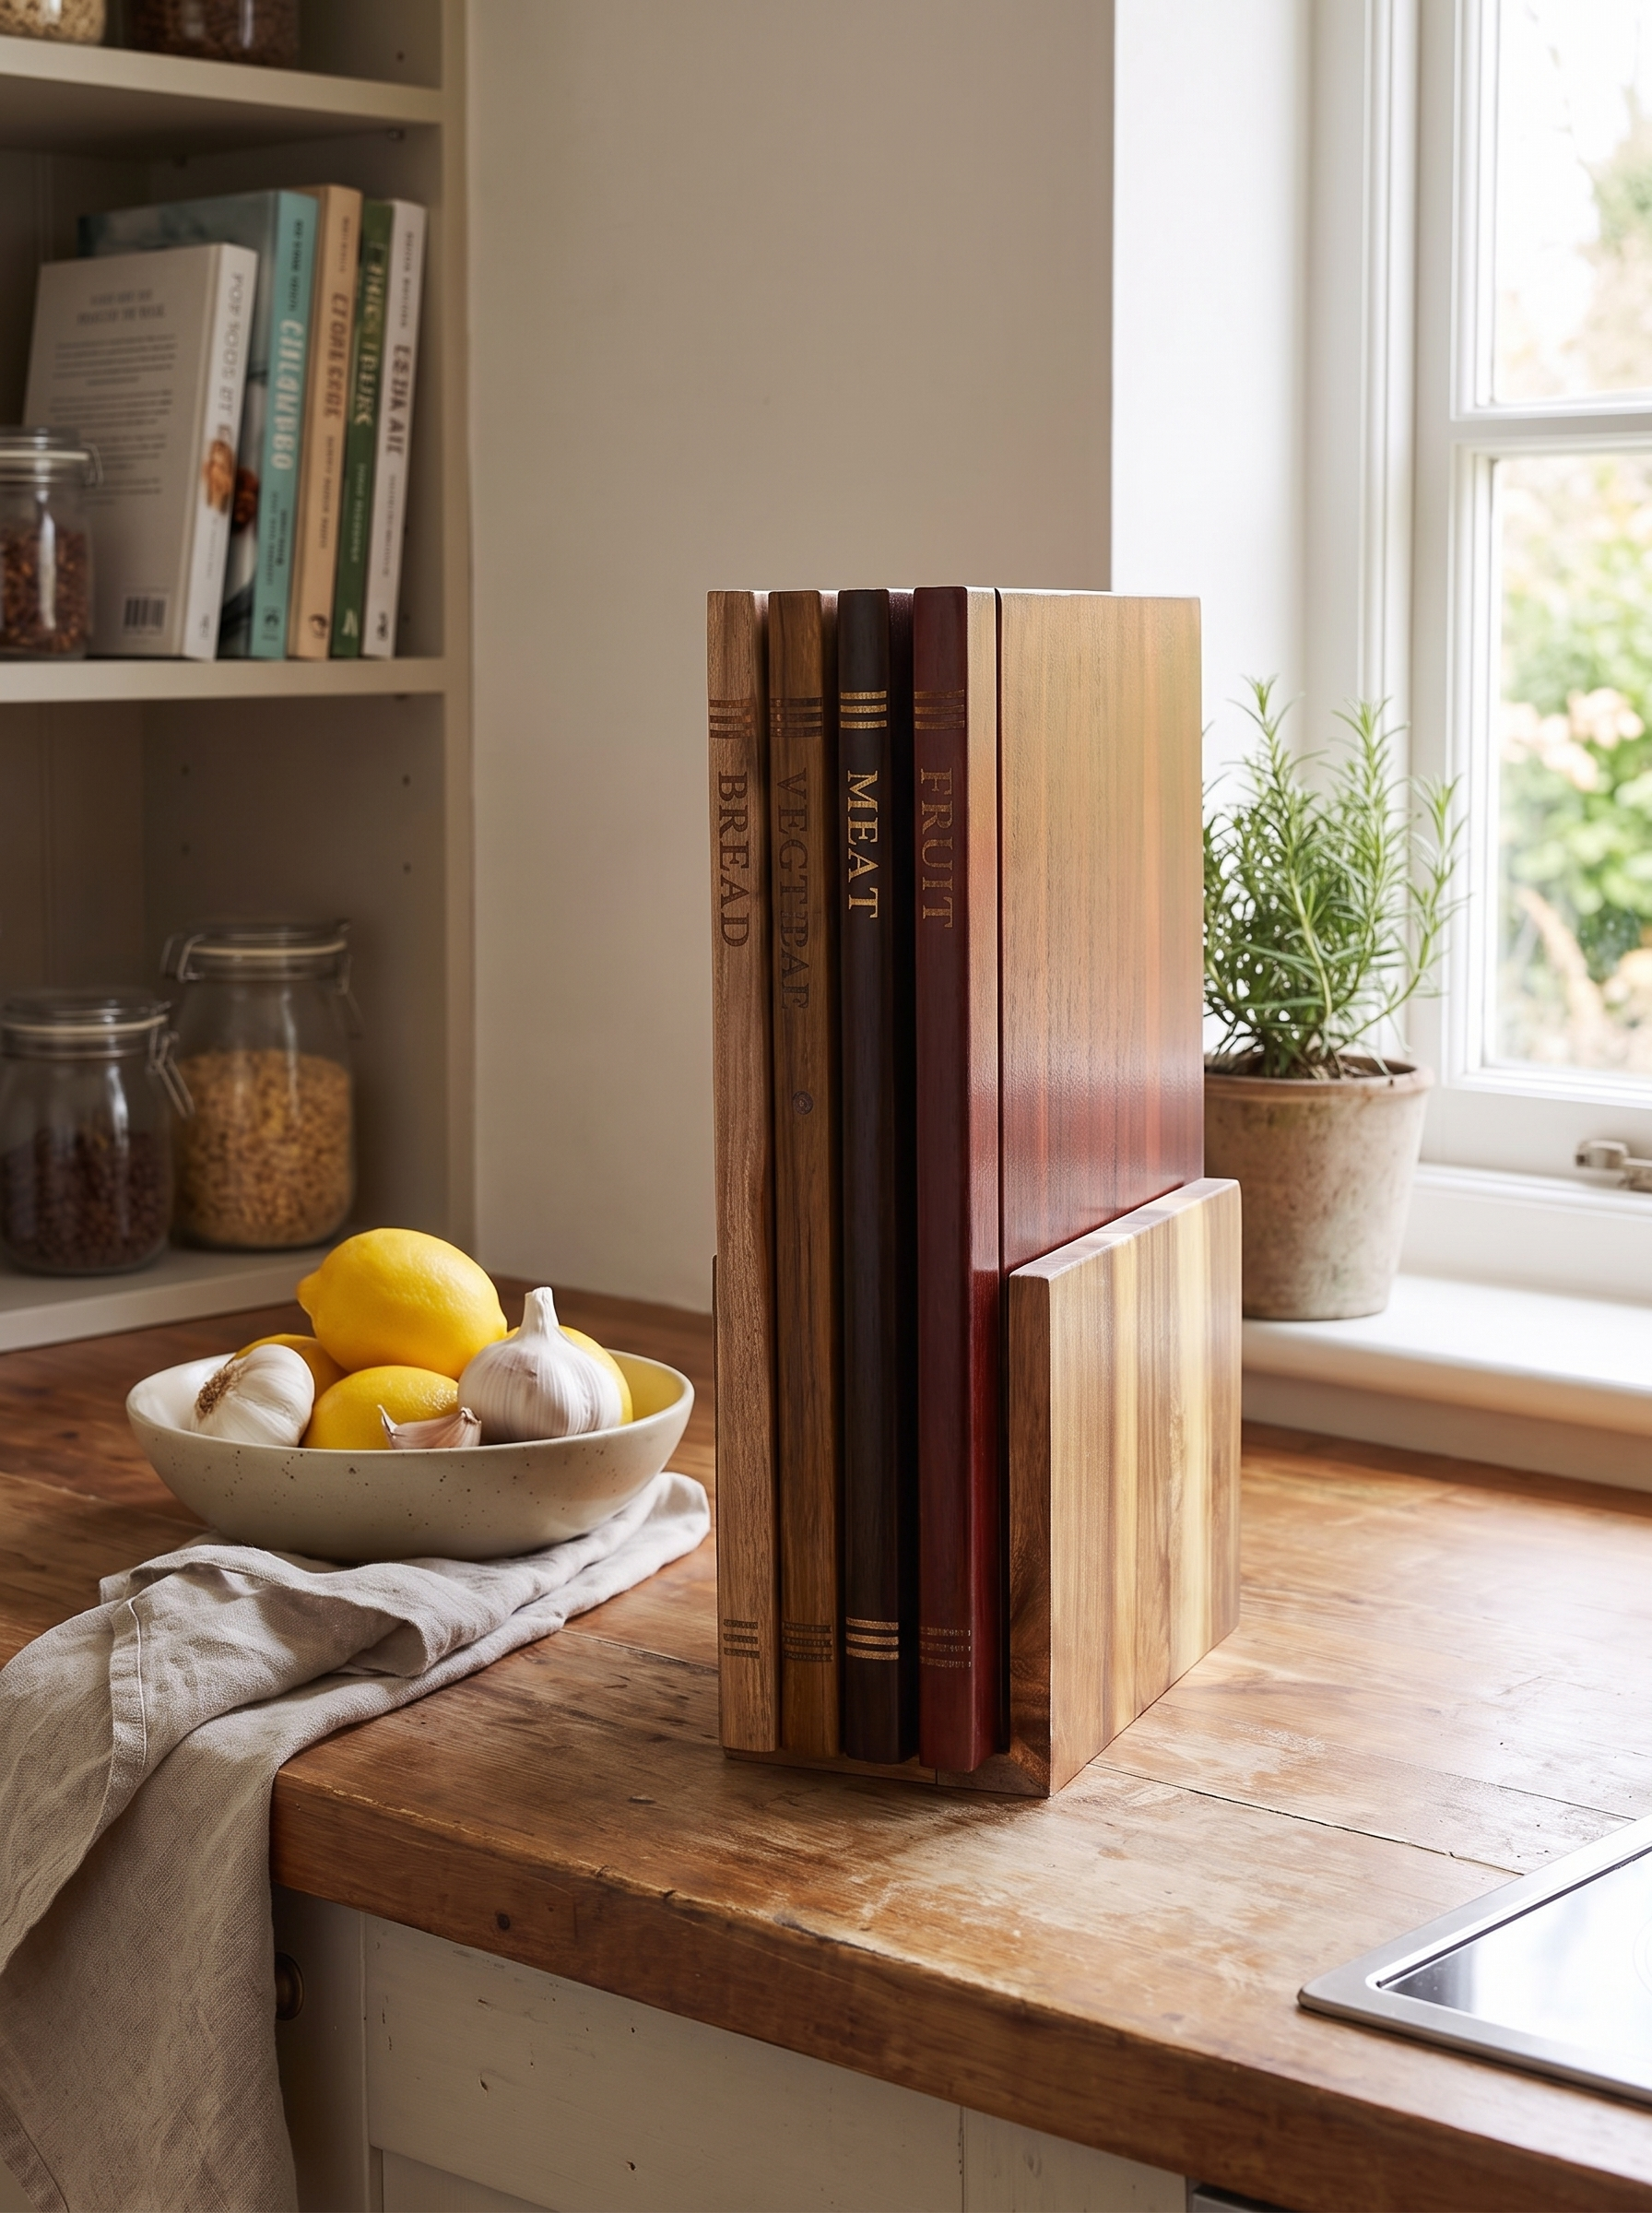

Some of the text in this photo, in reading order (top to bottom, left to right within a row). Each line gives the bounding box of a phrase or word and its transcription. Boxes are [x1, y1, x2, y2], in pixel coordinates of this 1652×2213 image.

[717, 771, 750, 948] BREAD
[846, 769, 879, 919] MEAT
[919, 767, 954, 929] FRUIT
